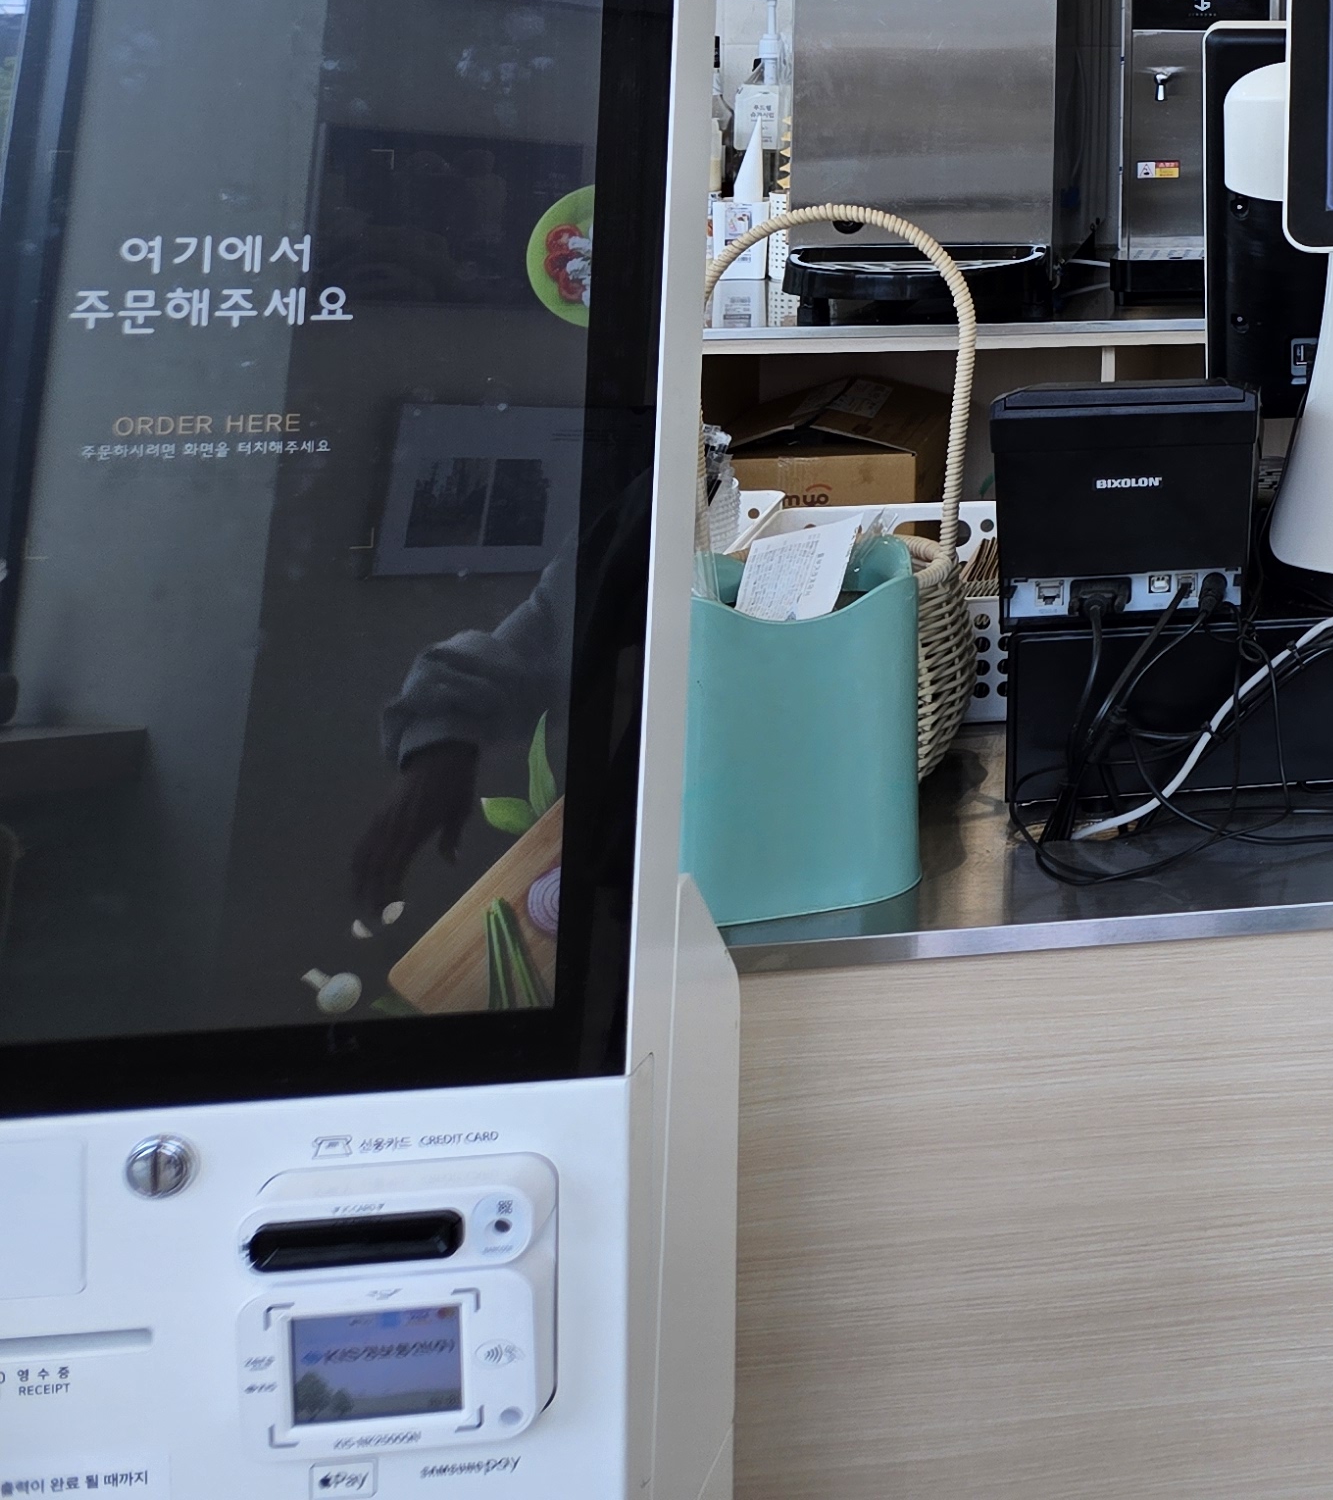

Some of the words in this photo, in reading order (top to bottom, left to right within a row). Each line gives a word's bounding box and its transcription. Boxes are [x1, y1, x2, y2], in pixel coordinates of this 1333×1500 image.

[120, 234, 313, 274] 여기에서
[69, 286, 355, 334] 주문해주세요
[113, 415, 213, 437] ORDER
[226, 413, 301, 434] HERE
[81, 442, 176, 461] 주문하시려면
[183, 441, 230, 458] 화면을
[237, 439, 331, 455] 터치해주세요
[1096, 477, 1162, 489] BIXOLON
[418, 1133, 463, 1147] CREDIT
[464, 1131, 499, 1143] CARD
[18, 1383, 70, 1396] RECEIPT
[50, 1476, 80, 1493] 완료
[103, 1470, 148, 1487] 때까지
